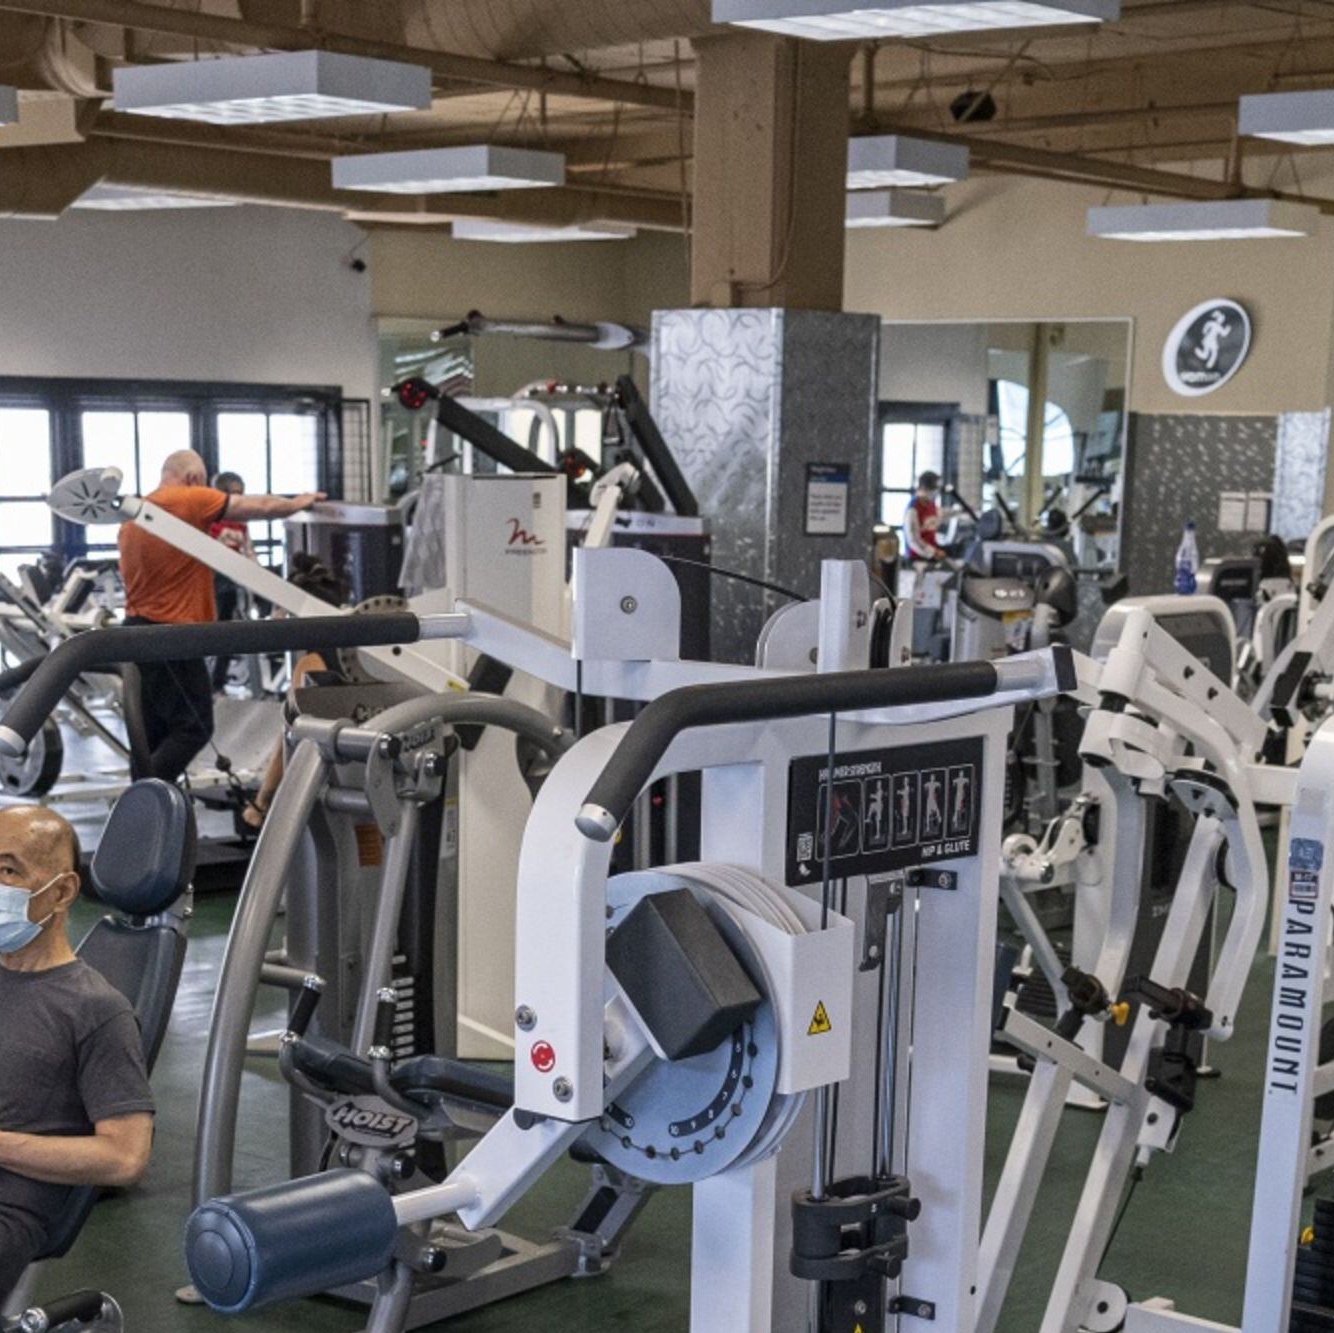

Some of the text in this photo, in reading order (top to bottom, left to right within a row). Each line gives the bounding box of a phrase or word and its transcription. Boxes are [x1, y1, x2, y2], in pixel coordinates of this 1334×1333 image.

[819, 766, 851, 782] HAMER
[922, 840, 970, 857] HIP & GLUTE
[1270, 899, 1316, 1094] PARAMOUNT
[331, 1103, 413, 1134] HOIST
